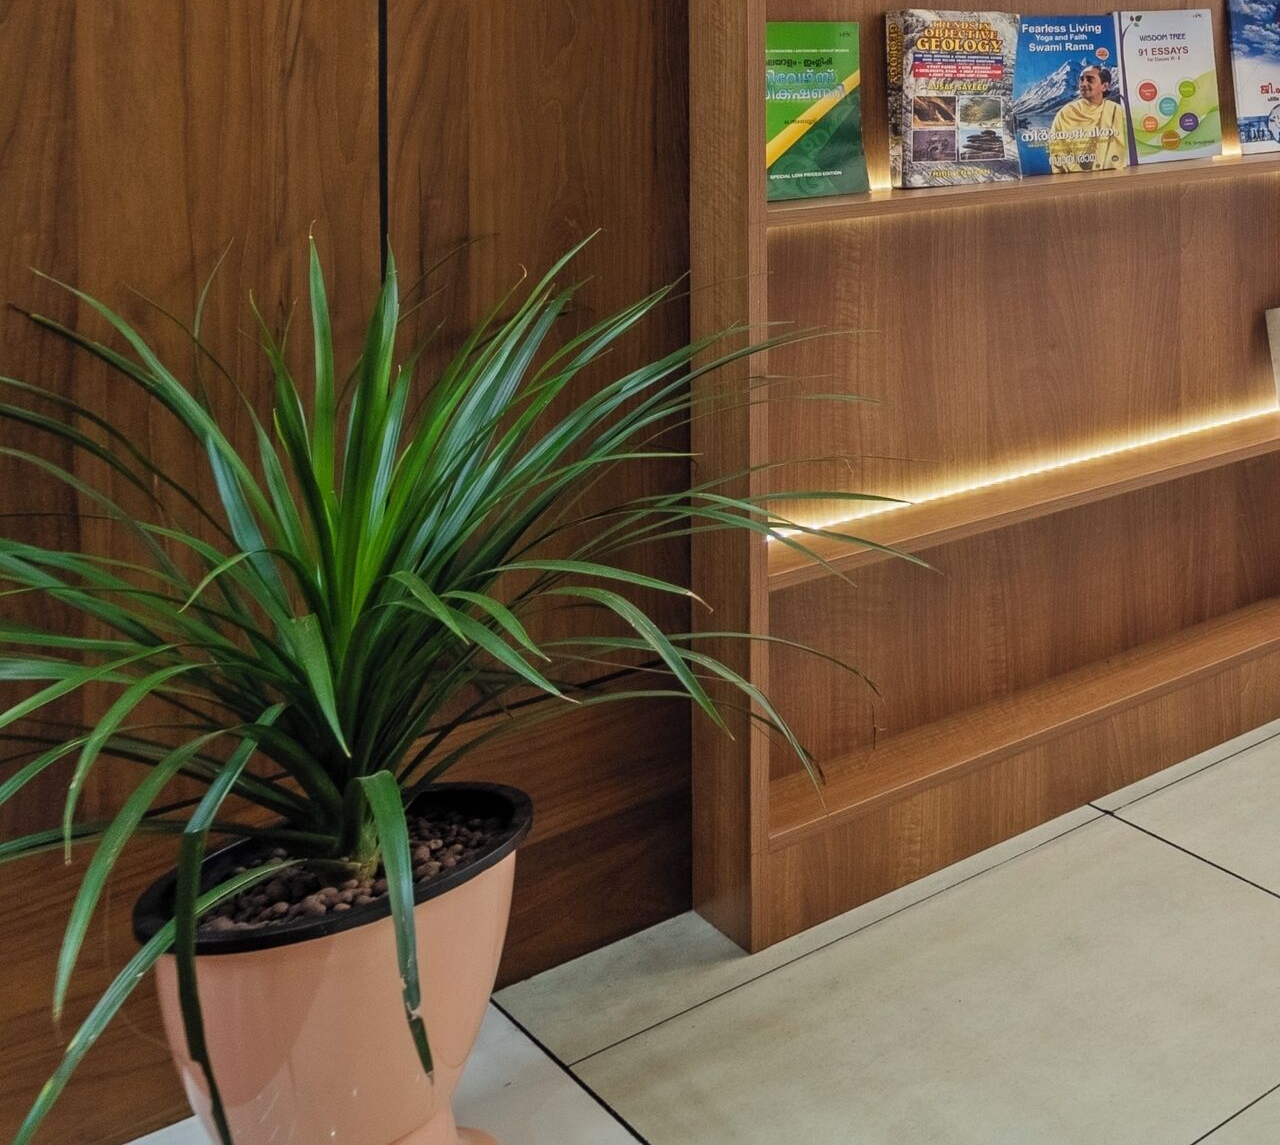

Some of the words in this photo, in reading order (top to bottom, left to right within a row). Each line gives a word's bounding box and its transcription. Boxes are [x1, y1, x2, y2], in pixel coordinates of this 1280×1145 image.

[924, 28, 999, 40] OBJECTIVE
[1022, 24, 1066, 33] Fearless
[1069, 23, 1101, 34] Living
[1036, 34, 1053, 42] Yoga
[1139, 34, 1168, 42] WISDOM
[916, 38, 1003, 53] GEOLOGY
[1029, 43, 1062, 52] Swami
[1065, 42, 1094, 51] Rama
[889, 23, 898, 84] GEOLOGY
[1138, 48, 1148, 57] 91
[1151, 46, 1189, 56] ESSAYS
[765, 58, 797, 68] ലയാളം
